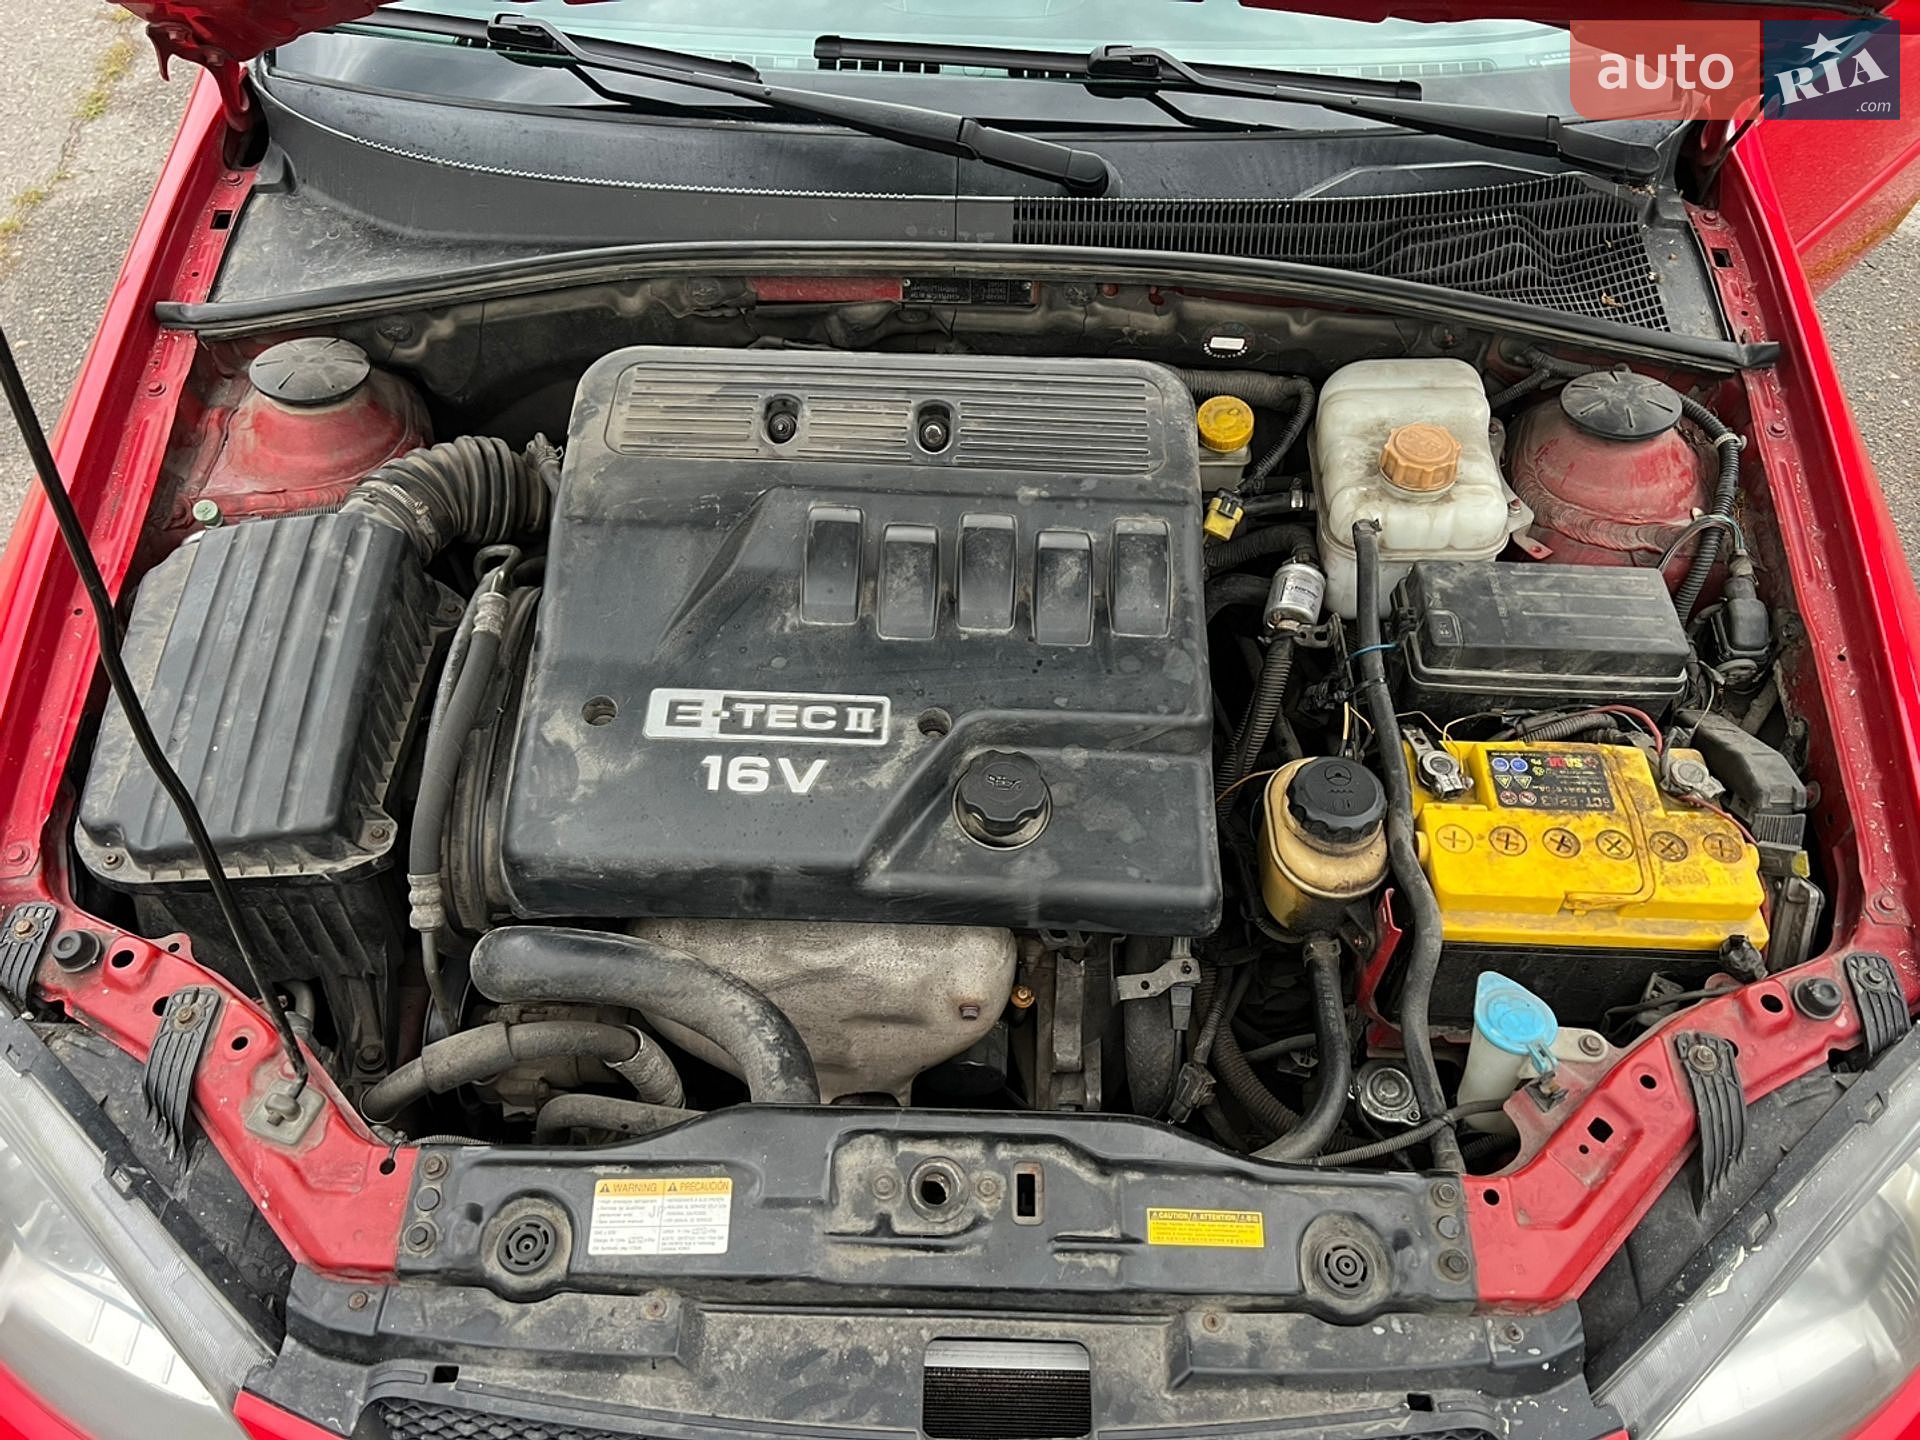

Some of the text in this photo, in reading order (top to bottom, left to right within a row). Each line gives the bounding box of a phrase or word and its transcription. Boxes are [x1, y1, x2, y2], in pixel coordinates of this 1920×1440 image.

[701, 755, 828, 793] 16V
[613, 1182, 657, 1192] WARNING
[1158, 1211, 1189, 1220] CAUTION
[1199, 1213, 1237, 1221] ATTENTION
